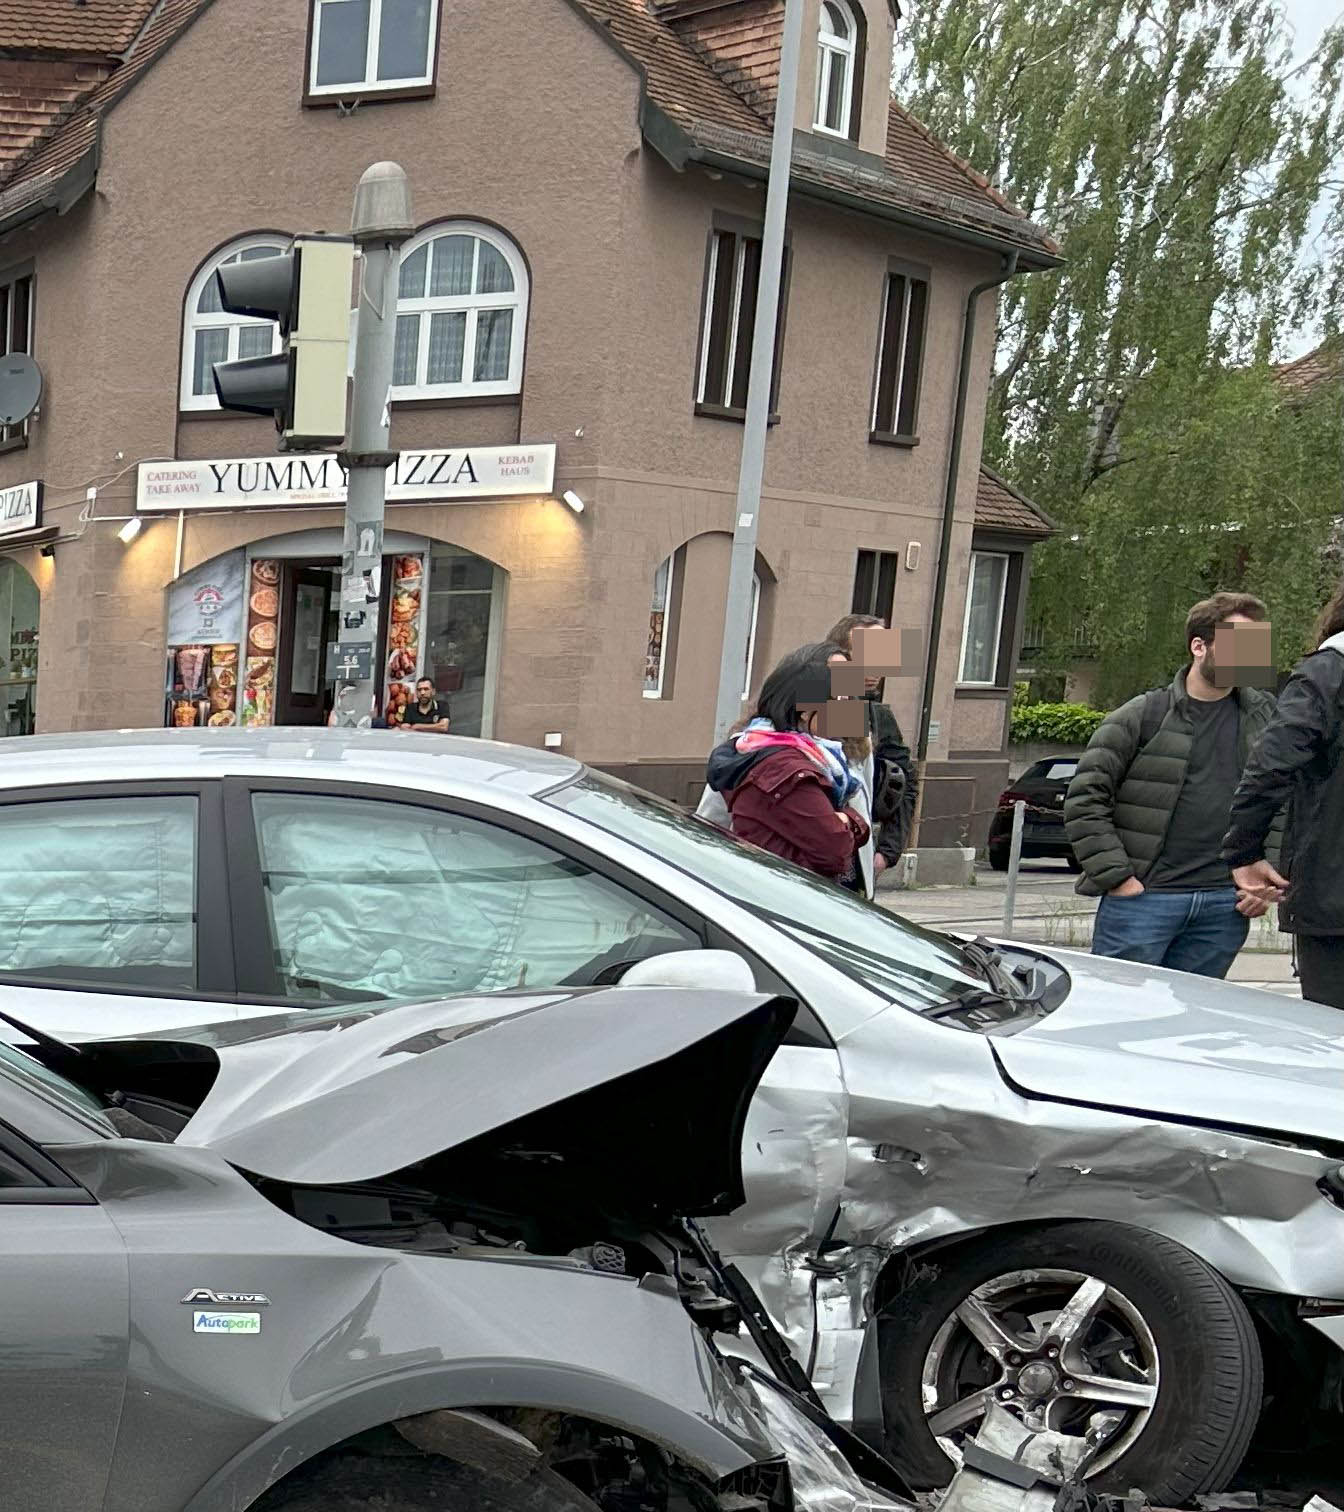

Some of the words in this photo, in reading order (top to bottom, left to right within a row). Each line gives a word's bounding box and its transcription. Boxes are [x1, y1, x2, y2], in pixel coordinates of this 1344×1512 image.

[498, 455, 535, 465] KEBAB
[146, 471, 197, 482] CATERING
[209, 459, 349, 493] YUMMY
[391, 453, 479, 485] IZZA
[500, 467, 531, 476] HAUS
[146, 485, 171, 495] TAKE
[173, 483, 201, 494] AWAY
[196, 1314, 259, 1332] Autopark
